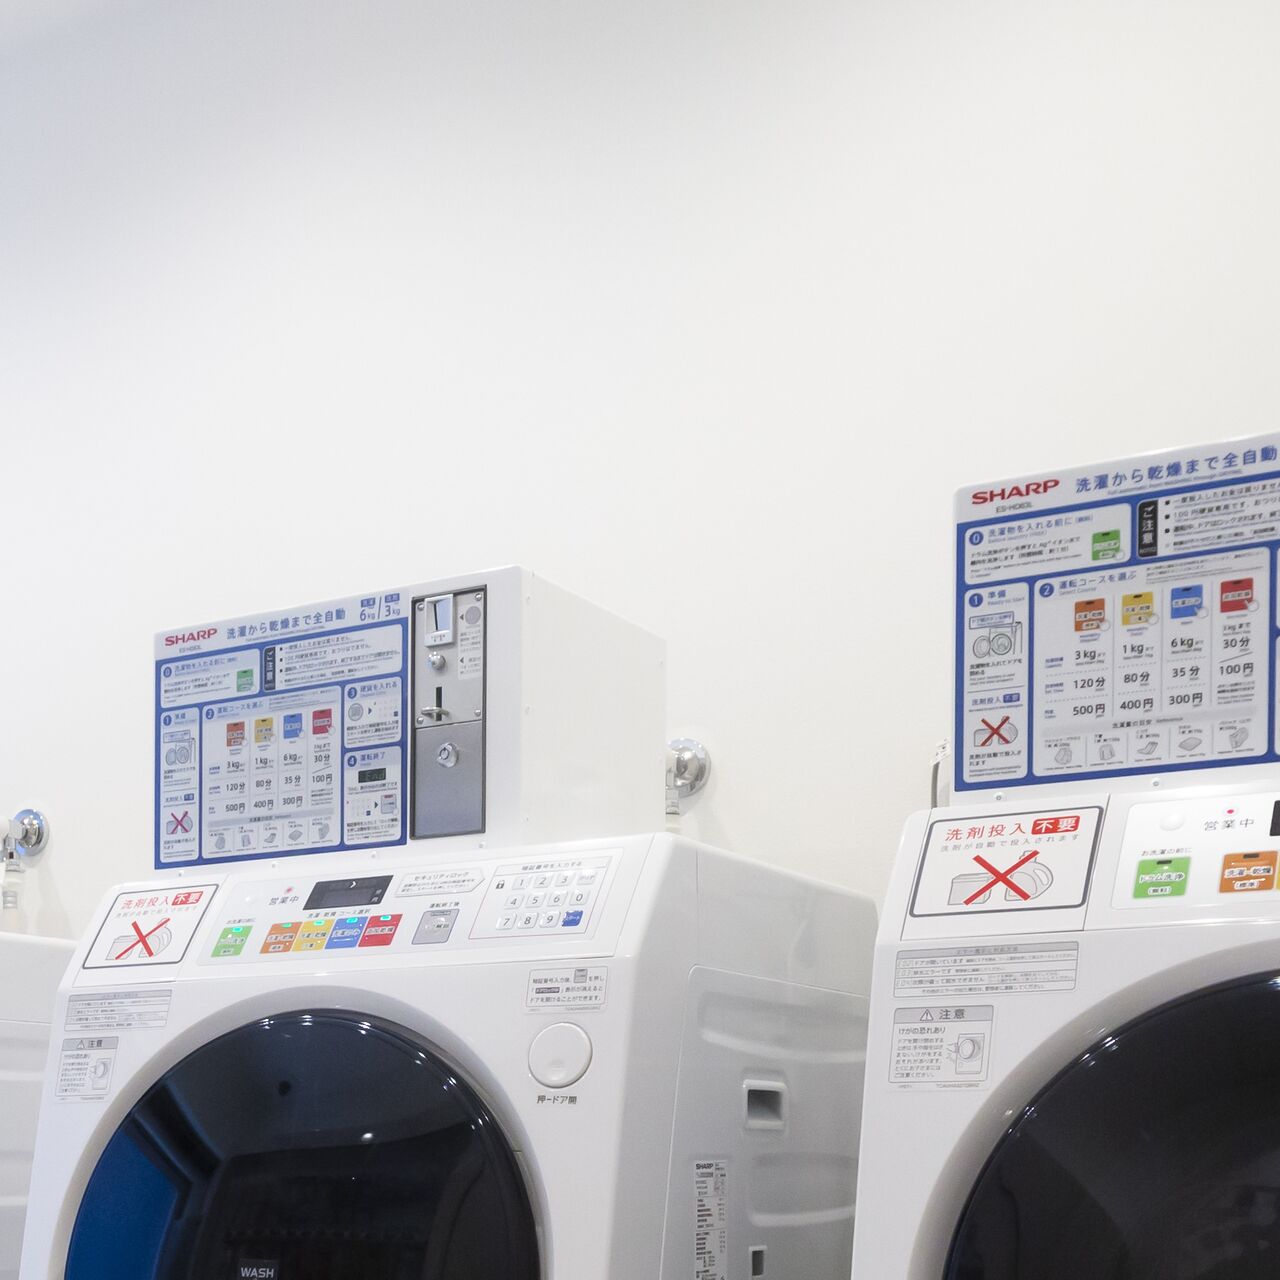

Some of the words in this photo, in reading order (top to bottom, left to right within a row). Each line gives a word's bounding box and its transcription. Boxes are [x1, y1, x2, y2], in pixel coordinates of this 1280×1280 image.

[1075, 445, 1277, 493] 洗濯から乾燥まで全自動
[972, 479, 1059, 505] SHARP
[988, 516, 1072, 537] 洗濯物を入れる前に
[1143, 507, 1155, 543] ご注意
[1059, 571, 1136, 590] 運転コースを選ぶ
[988, 590, 1006, 599] 準備
[226, 608, 346, 639] 洗濯から乾燥まで全自動
[165, 628, 218, 646] SHARP
[946, 823, 1027, 842] 洗剤投入
[1035, 817, 1078, 833] 不要
[1204, 818, 1255, 831] 営業中
[940, 833, 1080, 853] 洗剤が自動で投入されます
[539, 877, 547, 885] 2
[560, 875, 568, 883] 3
[268, 896, 300, 906] 営業中
[510, 898, 518, 906] 4
[532, 896, 538, 905] 5
[553, 894, 561, 903] 6
[576, 893, 583, 902] 0
[503, 918, 510, 927] 7
[524, 916, 532, 925] 8
[546, 915, 554, 924] 9
[939, 1009, 965, 1020] 注意
[898, 1027, 946, 1035] けがの恐れあり
[240, 1267, 274, 1278] WASH
